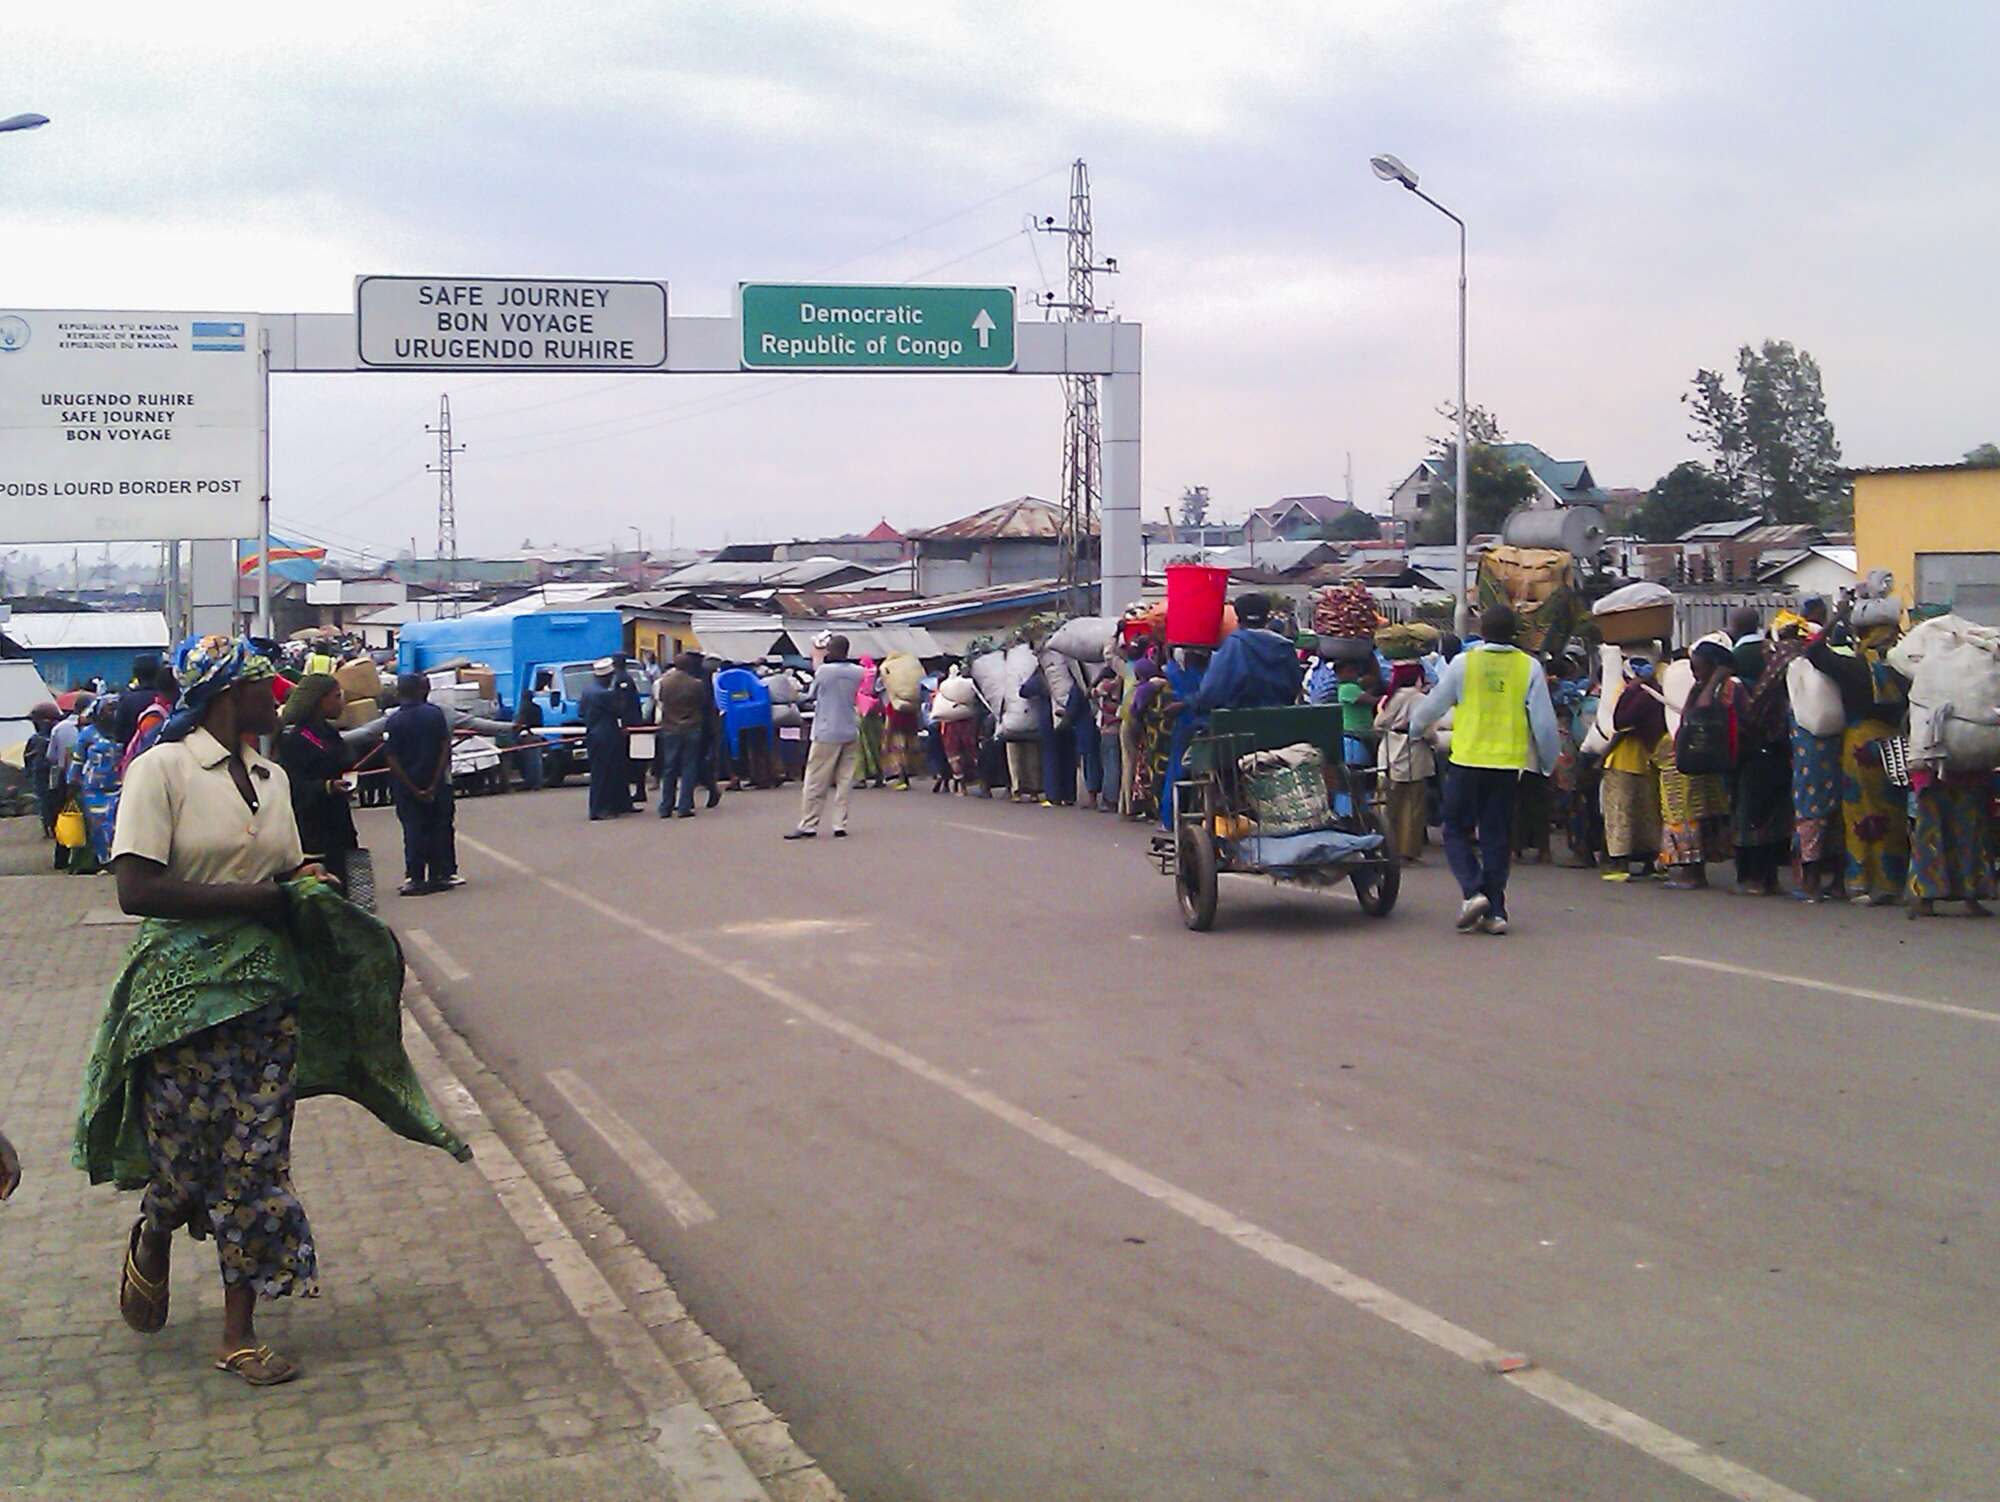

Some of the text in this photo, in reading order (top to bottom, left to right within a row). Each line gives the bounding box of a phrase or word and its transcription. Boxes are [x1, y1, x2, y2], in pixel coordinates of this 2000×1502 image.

[418, 285, 611, 308] SAFE JOURNEY
[437, 311, 595, 334] BON VOYAGE
[800, 303, 924, 325] Democratic
[66, 332, 111, 340] REPUBLIC
[130, 332, 172, 340] RWANDA
[137, 341, 179, 350] RWANDA
[394, 338, 635, 360] URUGENDO RUHIRE
[761, 332, 963, 359] Republic of Congo
[41, 393, 195, 406] URUGENDO RUHIRE
[60, 410, 176, 425] SAFE JOURNEY
[66, 428, 172, 442] BON VOYAGE
[0, 479, 242, 497] POIDS LOURD BORDER POST
